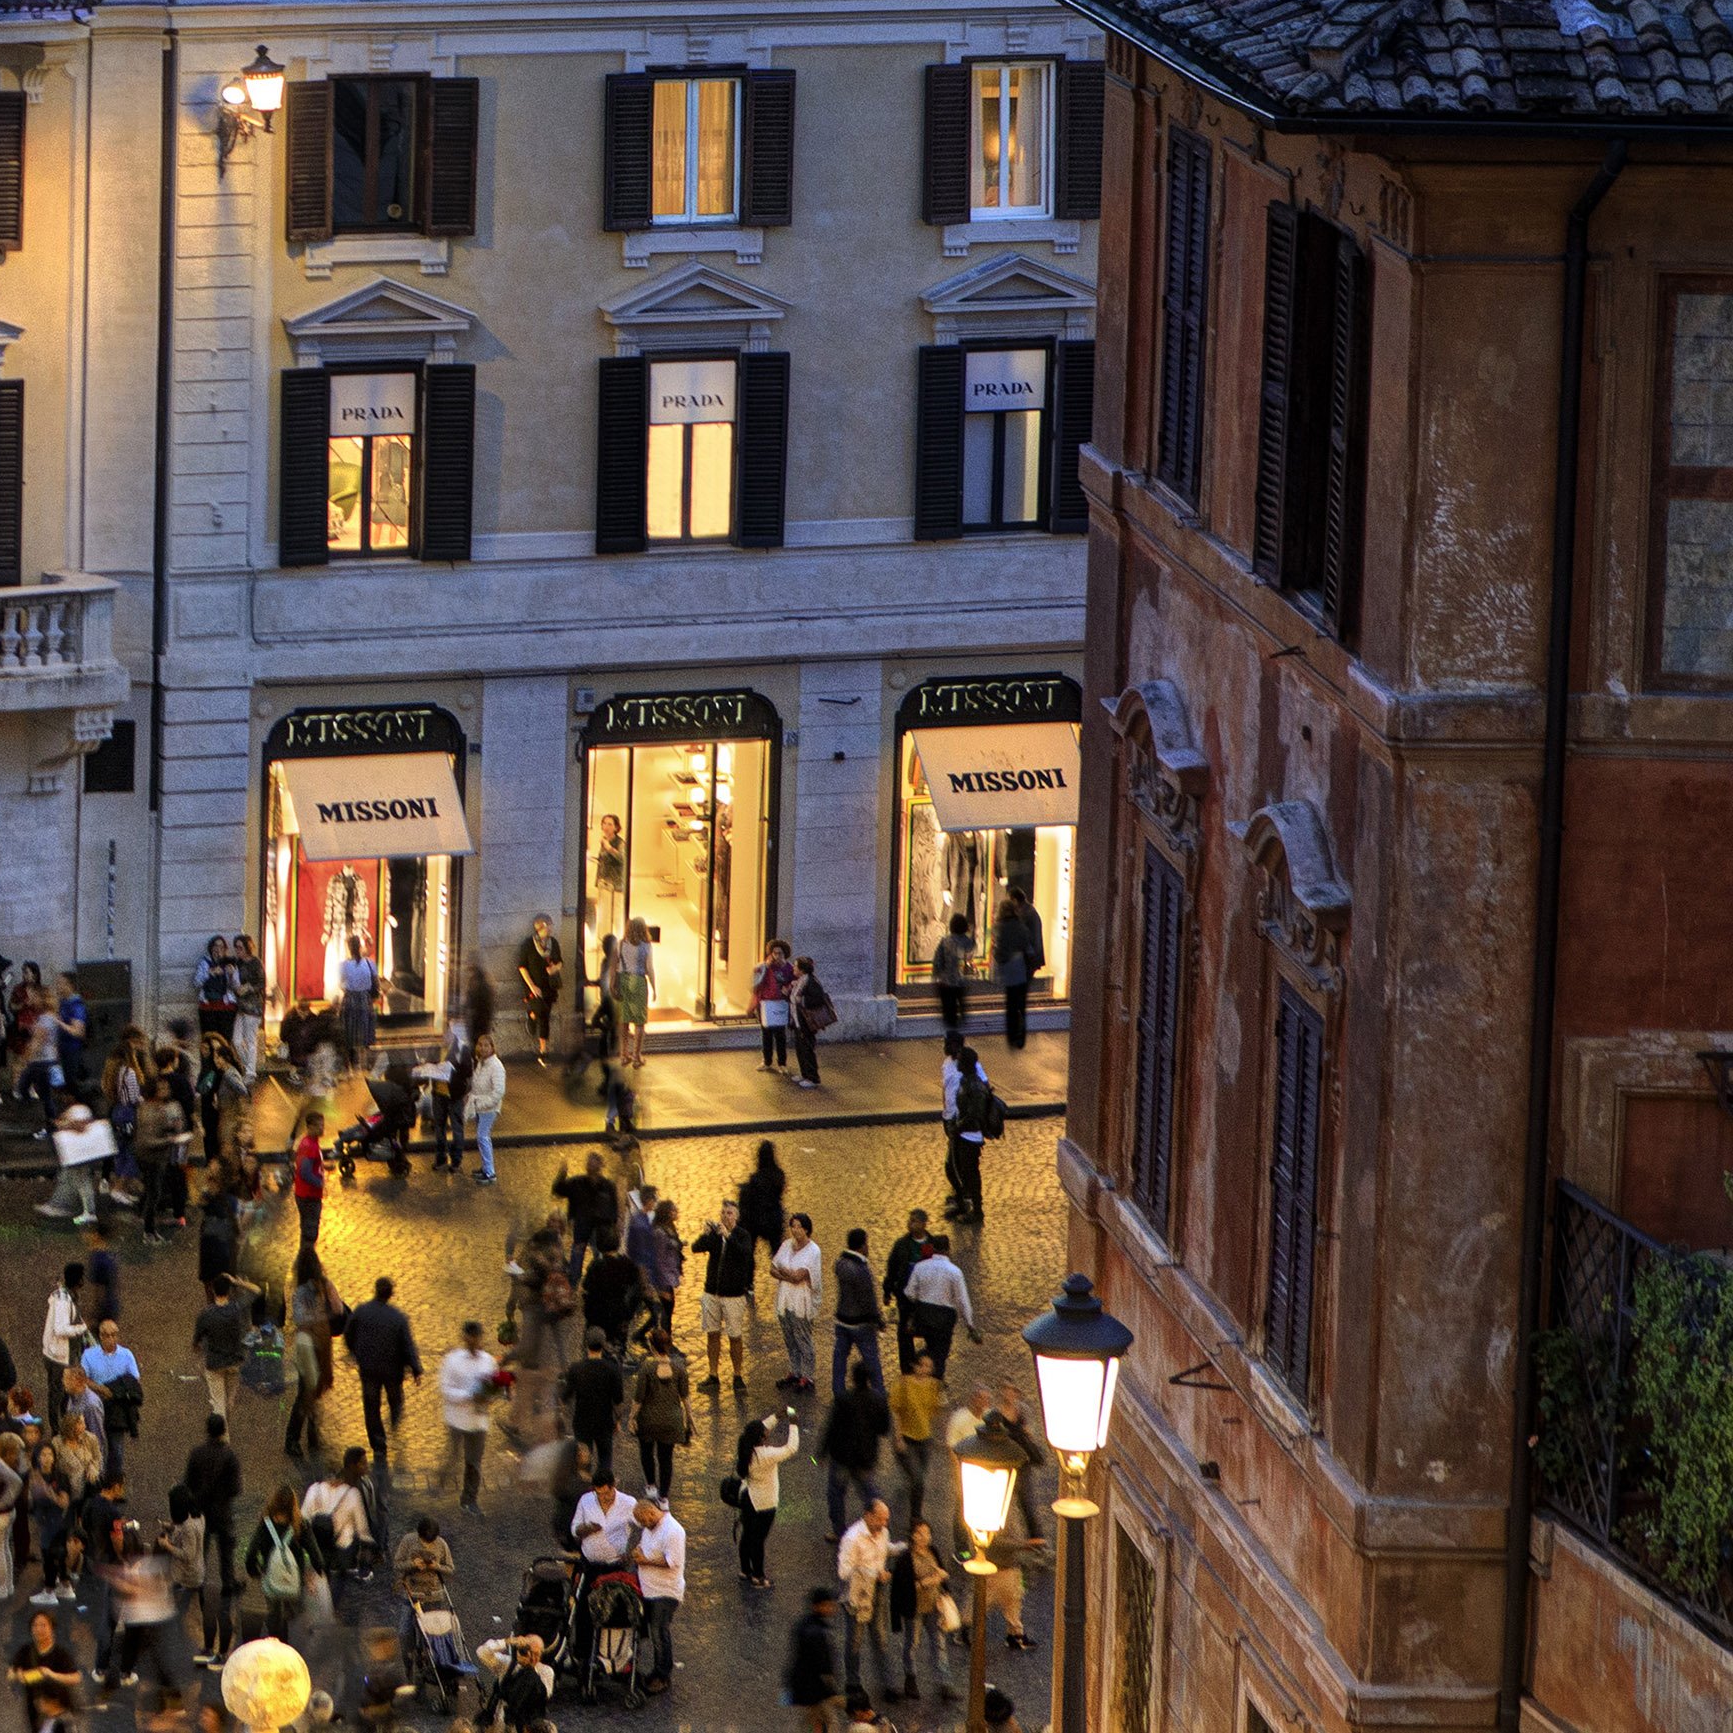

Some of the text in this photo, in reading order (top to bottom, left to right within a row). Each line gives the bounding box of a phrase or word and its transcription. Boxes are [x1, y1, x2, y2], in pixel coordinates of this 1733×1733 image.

[662, 394, 725, 408] PRADA
[973, 381, 1034, 396] PRADA
[341, 406, 405, 422] PRADA
[919, 680, 1062, 716] MISSONI
[605, 694, 747, 731] MISSONI
[287, 710, 433, 748] MISSONI
[947, 768, 1068, 793] MISSONI
[316, 798, 440, 823] MISSONI
